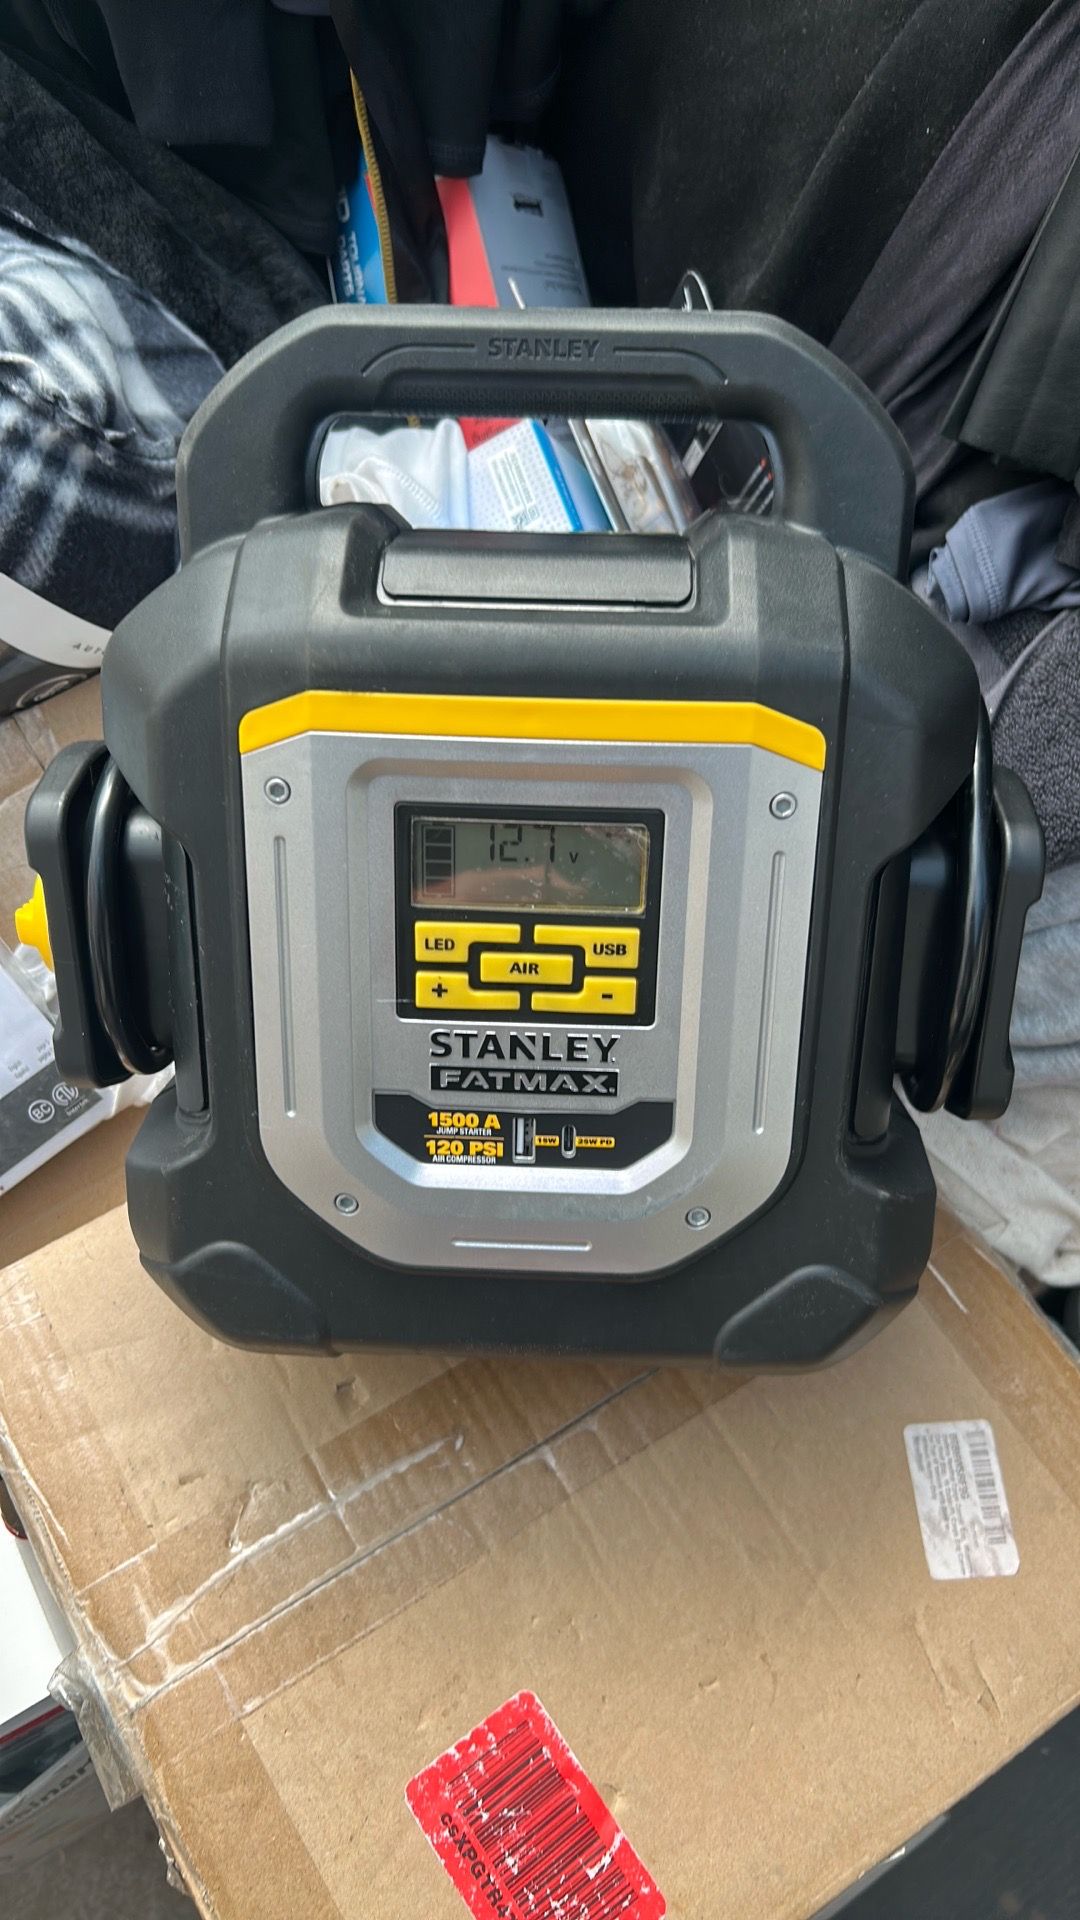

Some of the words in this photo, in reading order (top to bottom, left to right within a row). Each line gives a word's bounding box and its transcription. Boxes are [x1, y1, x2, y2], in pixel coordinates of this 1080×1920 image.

[488, 338, 601, 360] STANLEY
[424, 938, 455, 950] LED
[593, 943, 627, 956] USB
[510, 962, 539, 975] AIR
[429, 1028, 621, 1063] STANLEY
[428, 1111, 480, 1128] 1500
[484, 1113, 501, 1130] A
[436, 1127, 458, 1135] JUMP
[459, 1127, 492, 1136] STARTER
[426, 1140, 464, 1156] 120
[469, 1141, 504, 1157] PSI
[432, 1154, 445, 1163] AIR
[446, 1155, 496, 1164] COMPRESSOR
